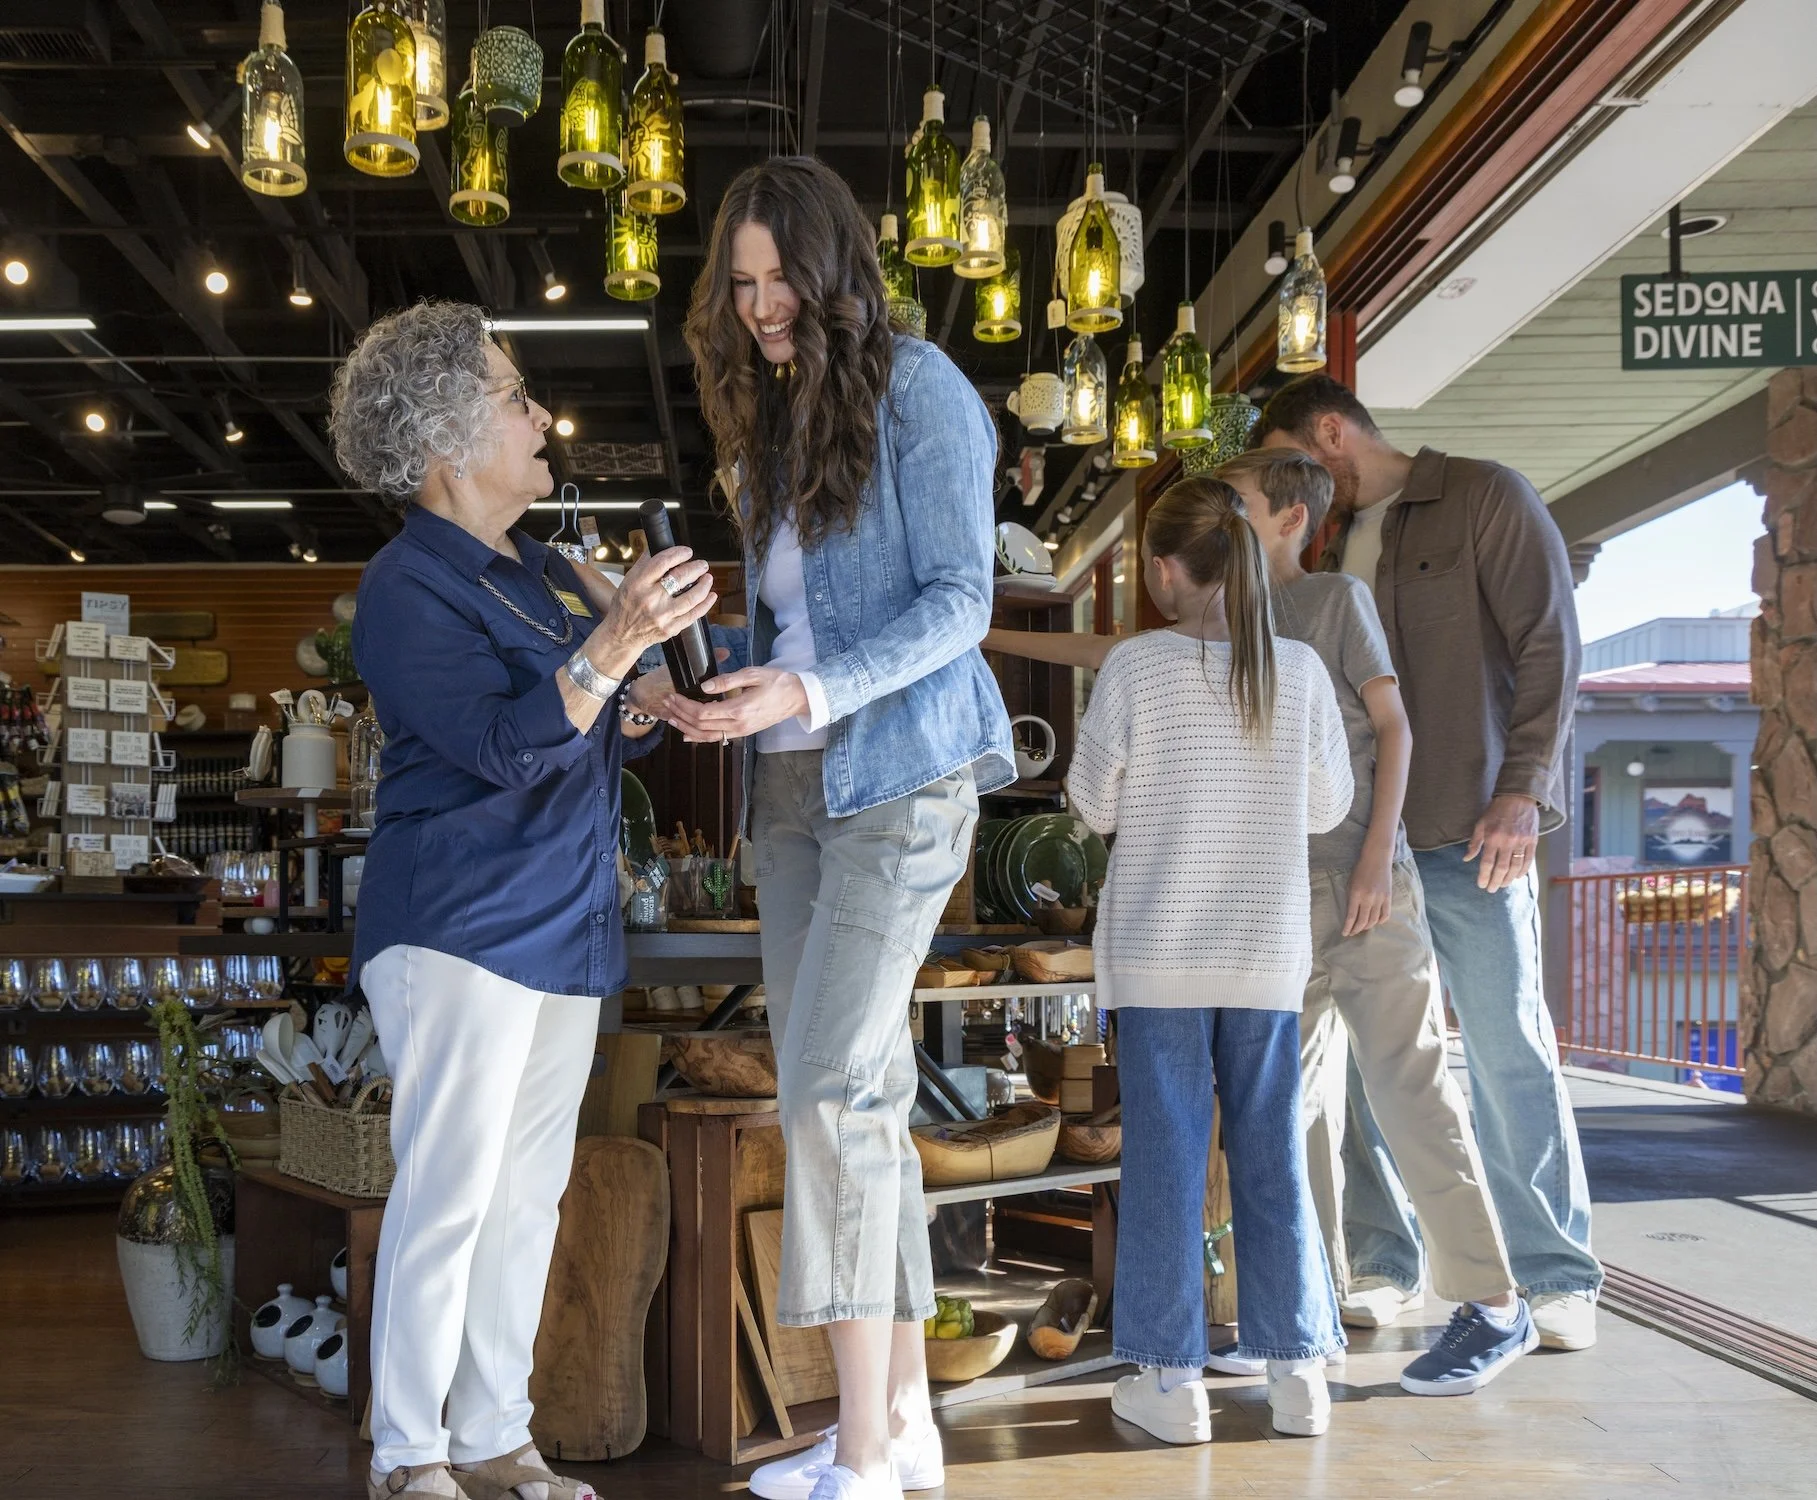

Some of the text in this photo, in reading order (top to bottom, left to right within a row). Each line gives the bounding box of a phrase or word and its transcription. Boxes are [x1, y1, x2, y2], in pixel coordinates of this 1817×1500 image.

[1633, 280, 1787, 318] SEDONA
[1633, 323, 1763, 359] DIVINE
[87, 599, 128, 610] TIPSY
